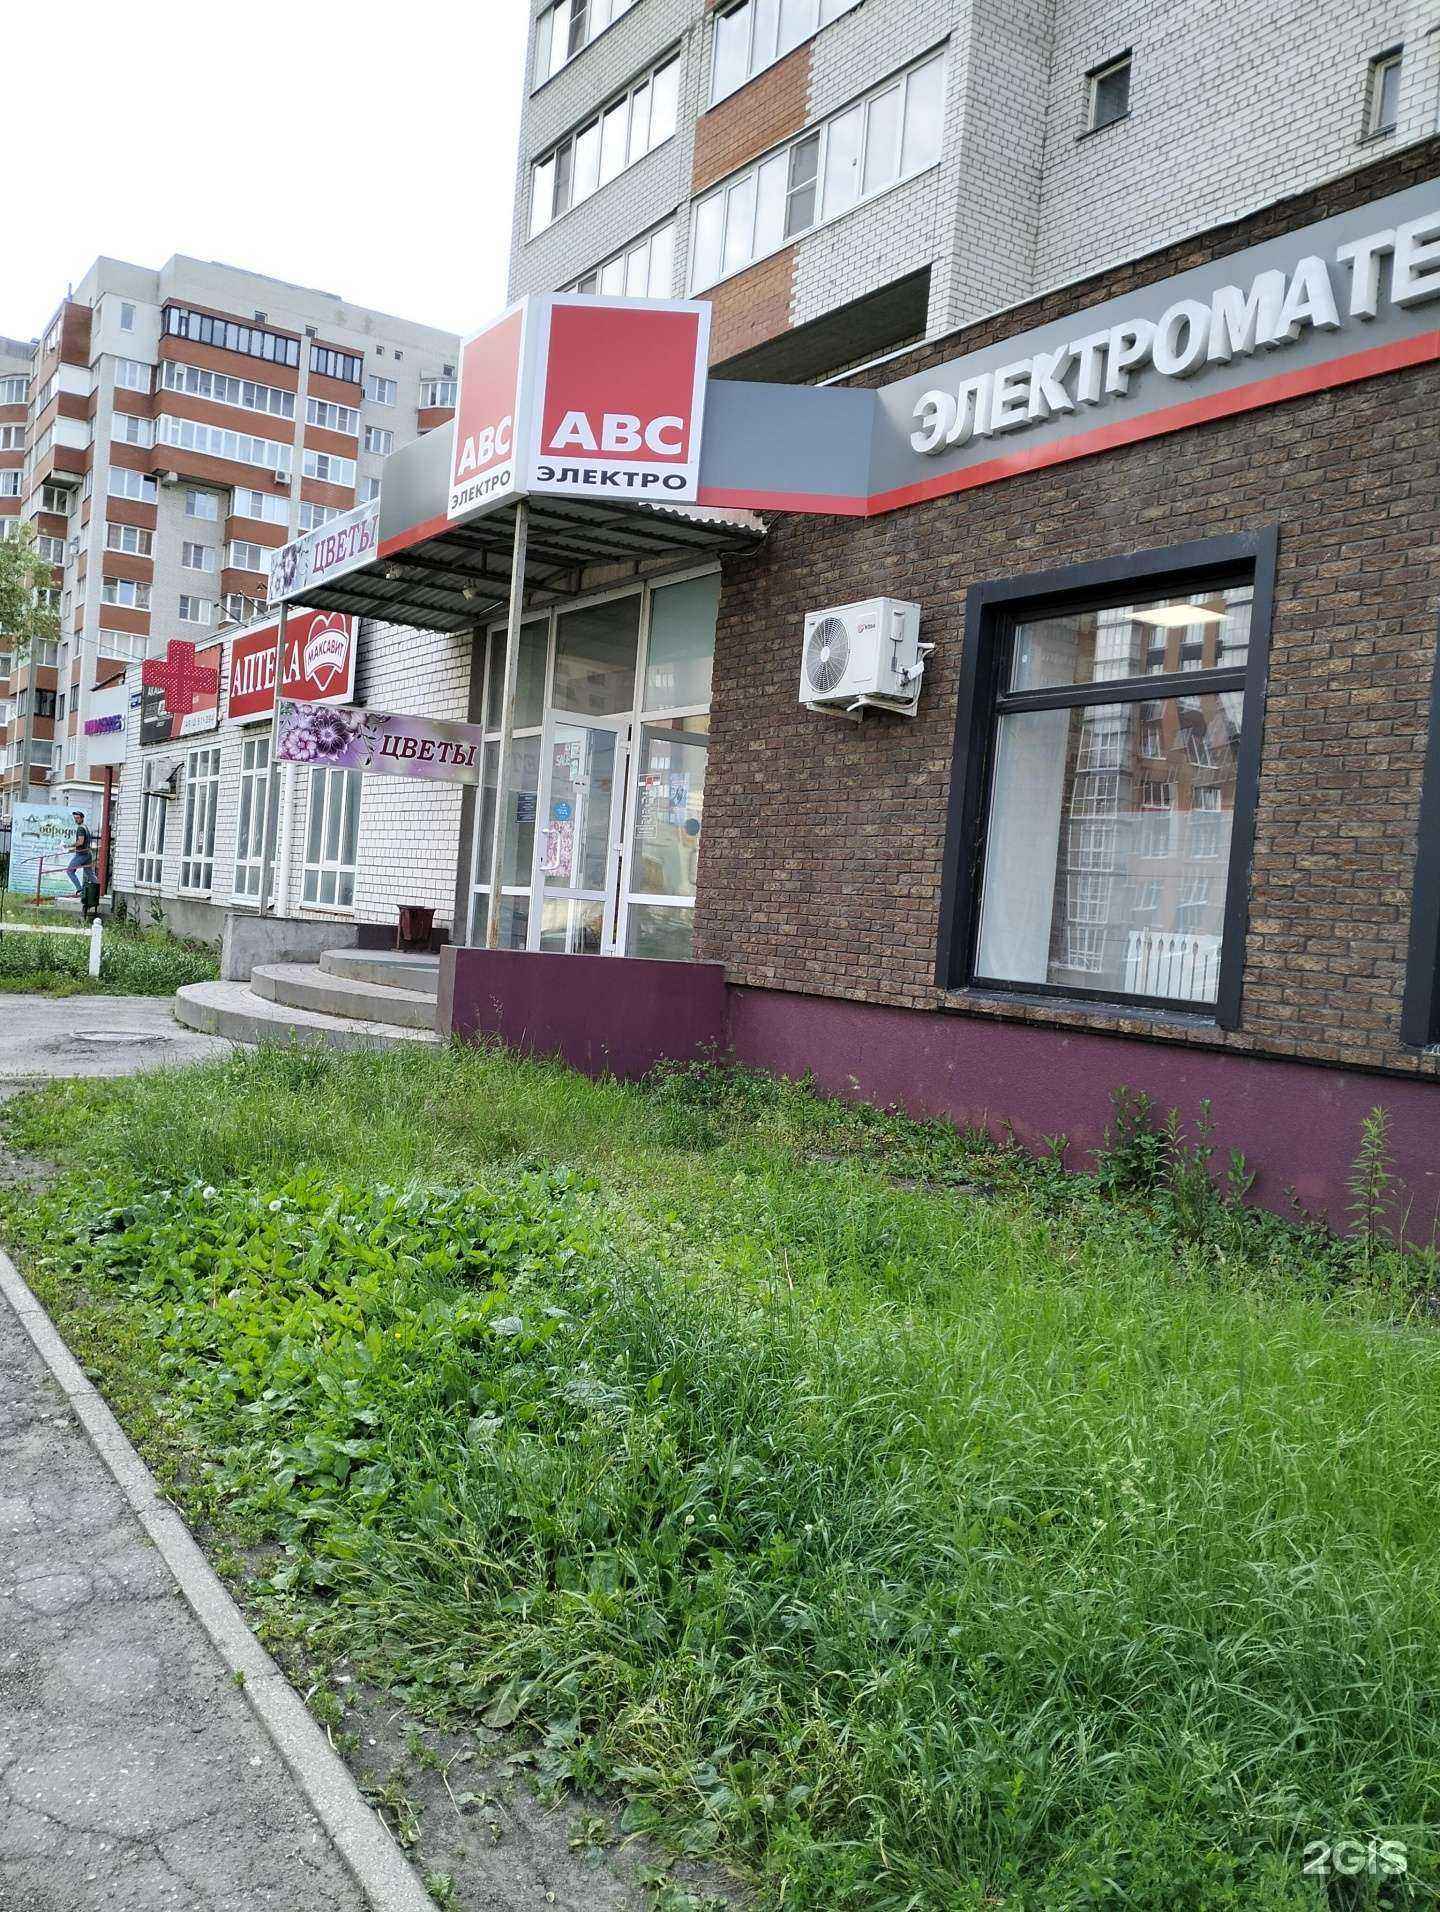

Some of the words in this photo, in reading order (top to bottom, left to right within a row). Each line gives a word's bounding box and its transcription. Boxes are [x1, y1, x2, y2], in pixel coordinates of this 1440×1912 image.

[910, 211, 1440, 456] ЭЛЕКТРОМАТЕ
[457, 415, 512, 476] АВС
[548, 410, 685, 455] АВС
[450, 469, 511, 510] ЭЛЕКТРО
[536, 465, 687, 491] ЭЛЕКТРО
[312, 513, 379, 574] ЦВЕТЫ
[307, 639, 345, 664] МАКСАВИТ
[379, 734, 478, 767] ЦВЕТЫ
